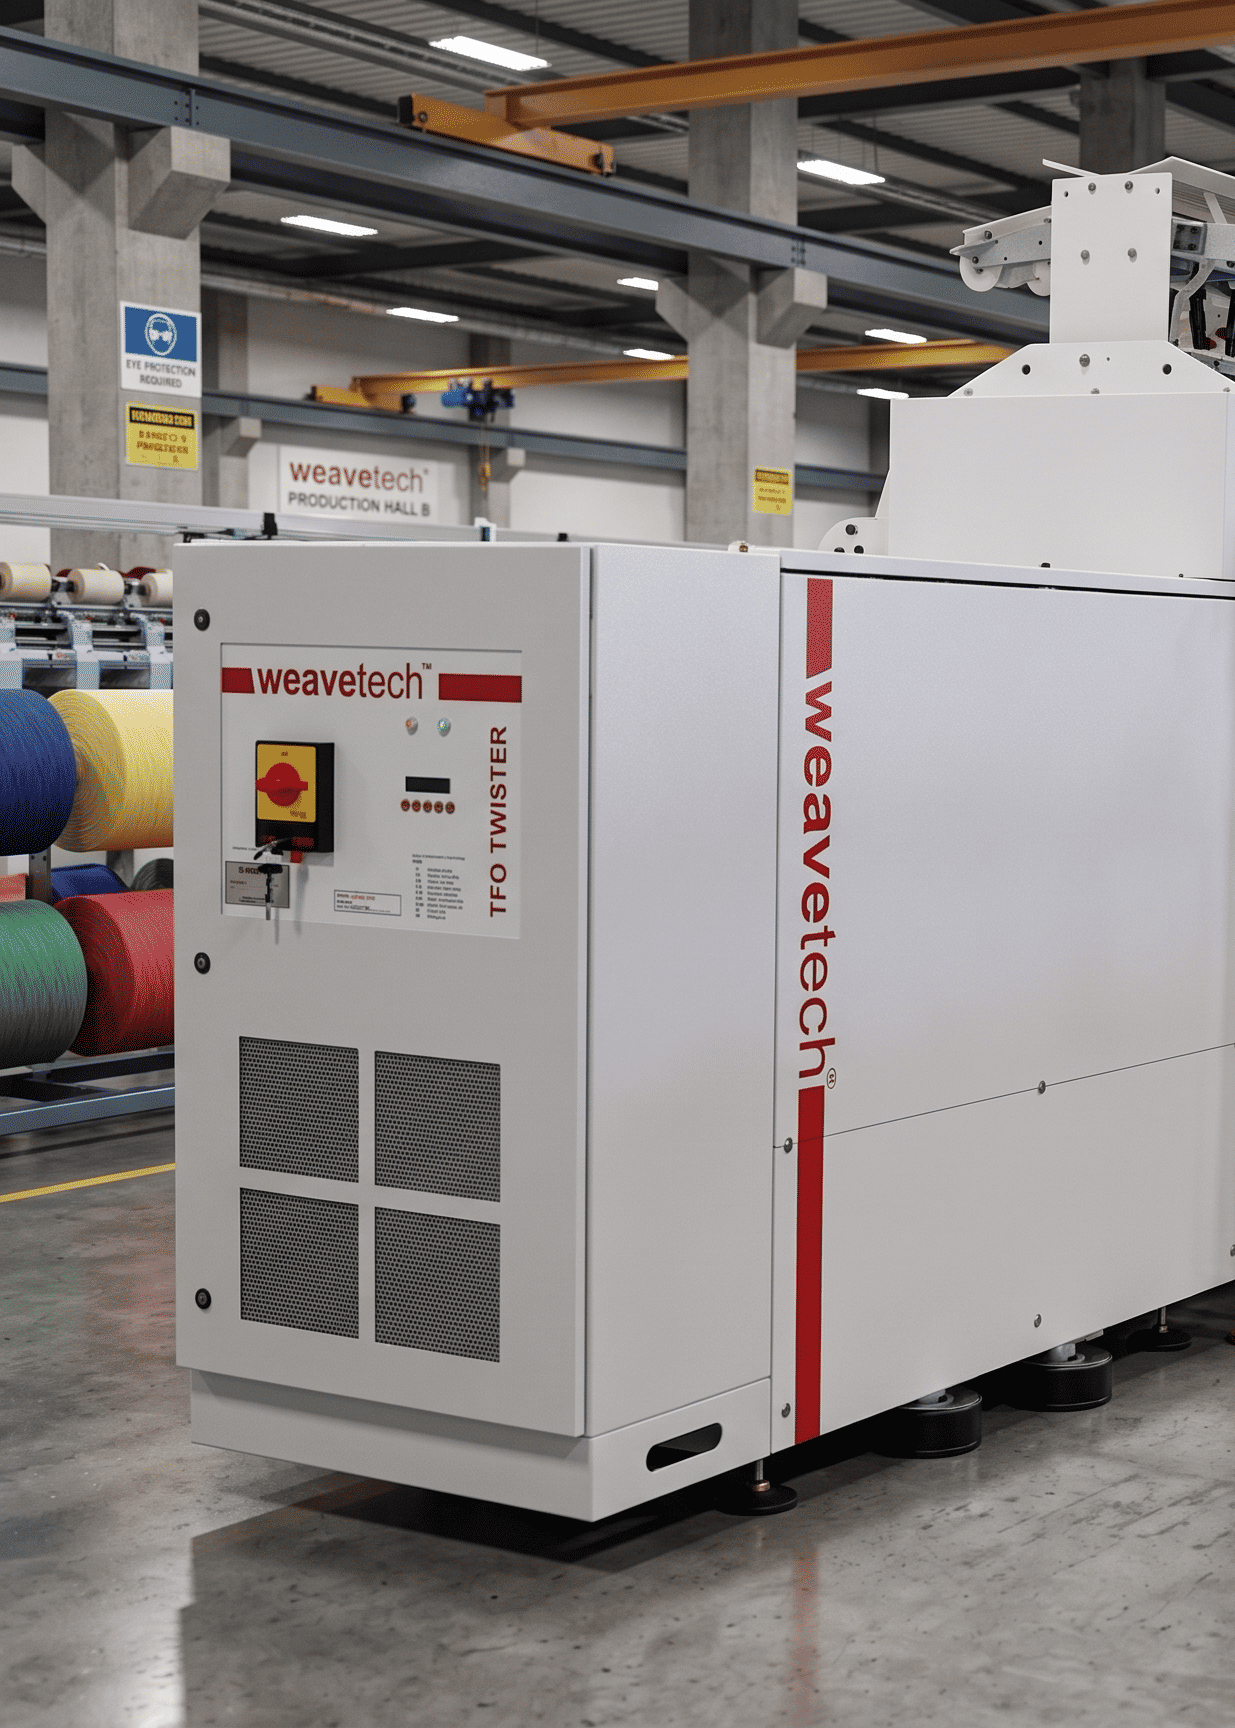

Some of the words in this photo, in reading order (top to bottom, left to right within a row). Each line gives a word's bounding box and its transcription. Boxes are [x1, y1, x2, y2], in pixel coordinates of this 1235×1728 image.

[126, 359, 142, 370] EYE
[144, 360, 196, 377] PROTECTION
[288, 491, 381, 512] PRODUCTION
[384, 501, 418, 517] HALL
[421, 503, 431, 518] B
[489, 726, 508, 854] TWISTER
[489, 863, 508, 918] TFO
